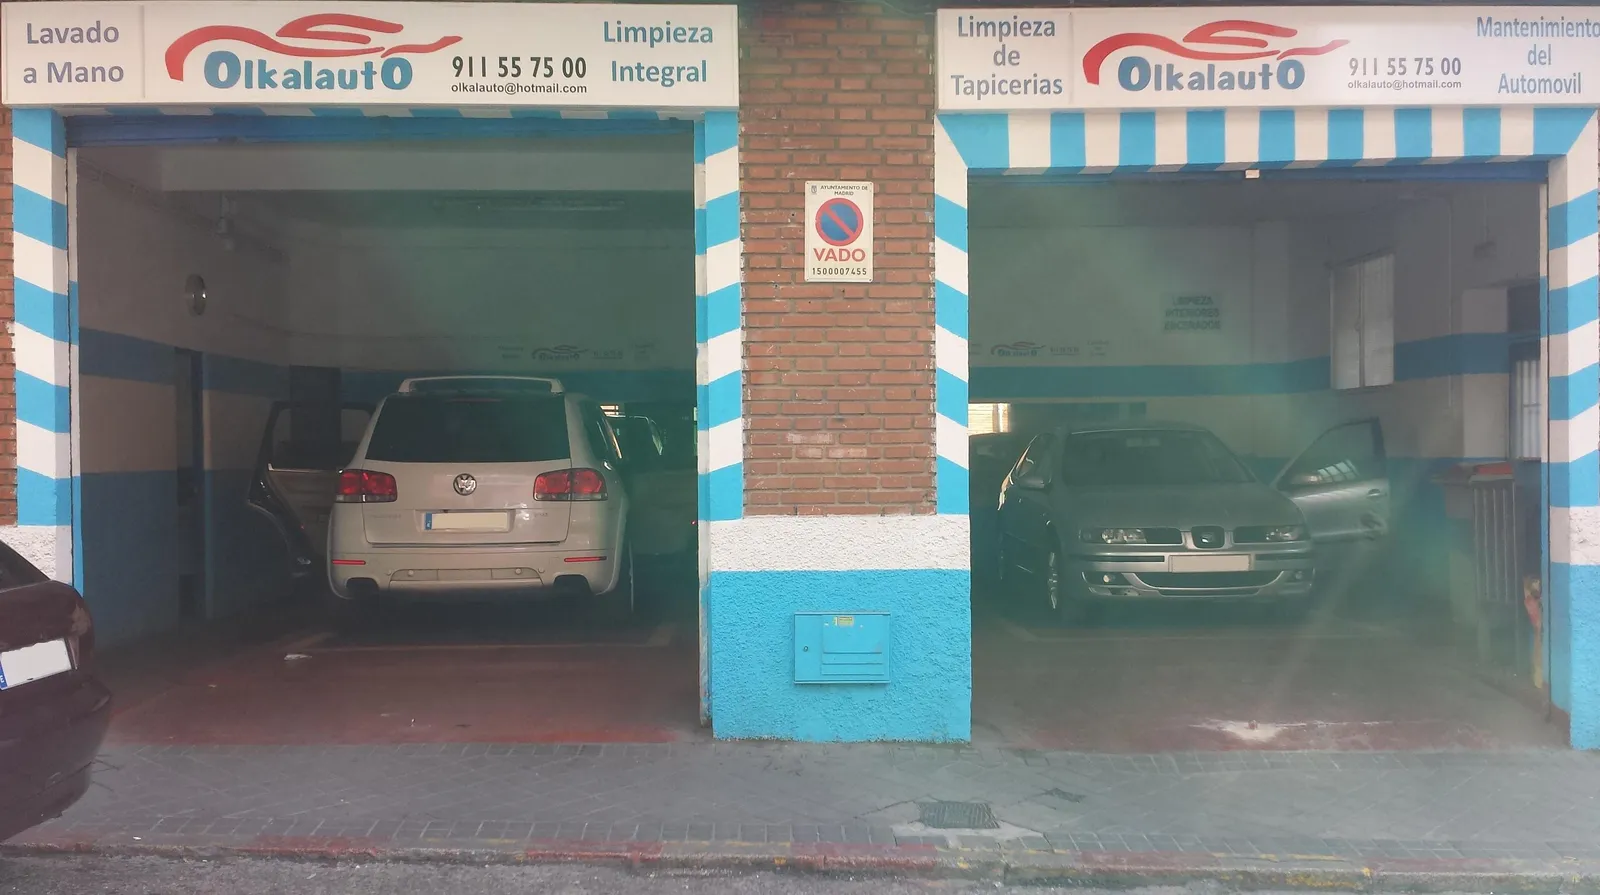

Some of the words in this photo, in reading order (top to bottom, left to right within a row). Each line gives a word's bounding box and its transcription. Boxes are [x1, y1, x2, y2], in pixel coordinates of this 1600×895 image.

[26, 21, 120, 44] Lavado
[603, 21, 713, 48] Limpieza
[957, 15, 1056, 42] Limpieza
[1476, 16, 1600, 38] Mantenimiento
[993, 44, 1020, 66] de
[1527, 44, 1552, 66] del
[23, 67, 37, 83] a
[47, 62, 124, 83] Mano
[452, 56, 487, 77] 911
[498, 57, 521, 77] 55
[531, 57, 553, 78] 75
[562, 57, 587, 78] 00
[611, 60, 707, 87] Integral
[1349, 58, 1377, 76] 911
[1387, 58, 1407, 76] 55
[1414, 58, 1434, 76] 75
[1440, 58, 1462, 76] 00
[451, 83, 587, 95] olkalauto@hotmail.com
[950, 73, 1063, 100] Tapicerias
[1347, 80, 1462, 90] olkalauto@hotmail.com
[1497, 72, 1582, 94] Automovil
[813, 248, 866, 262] VADO
[812, 267, 867, 275] 1500007455
